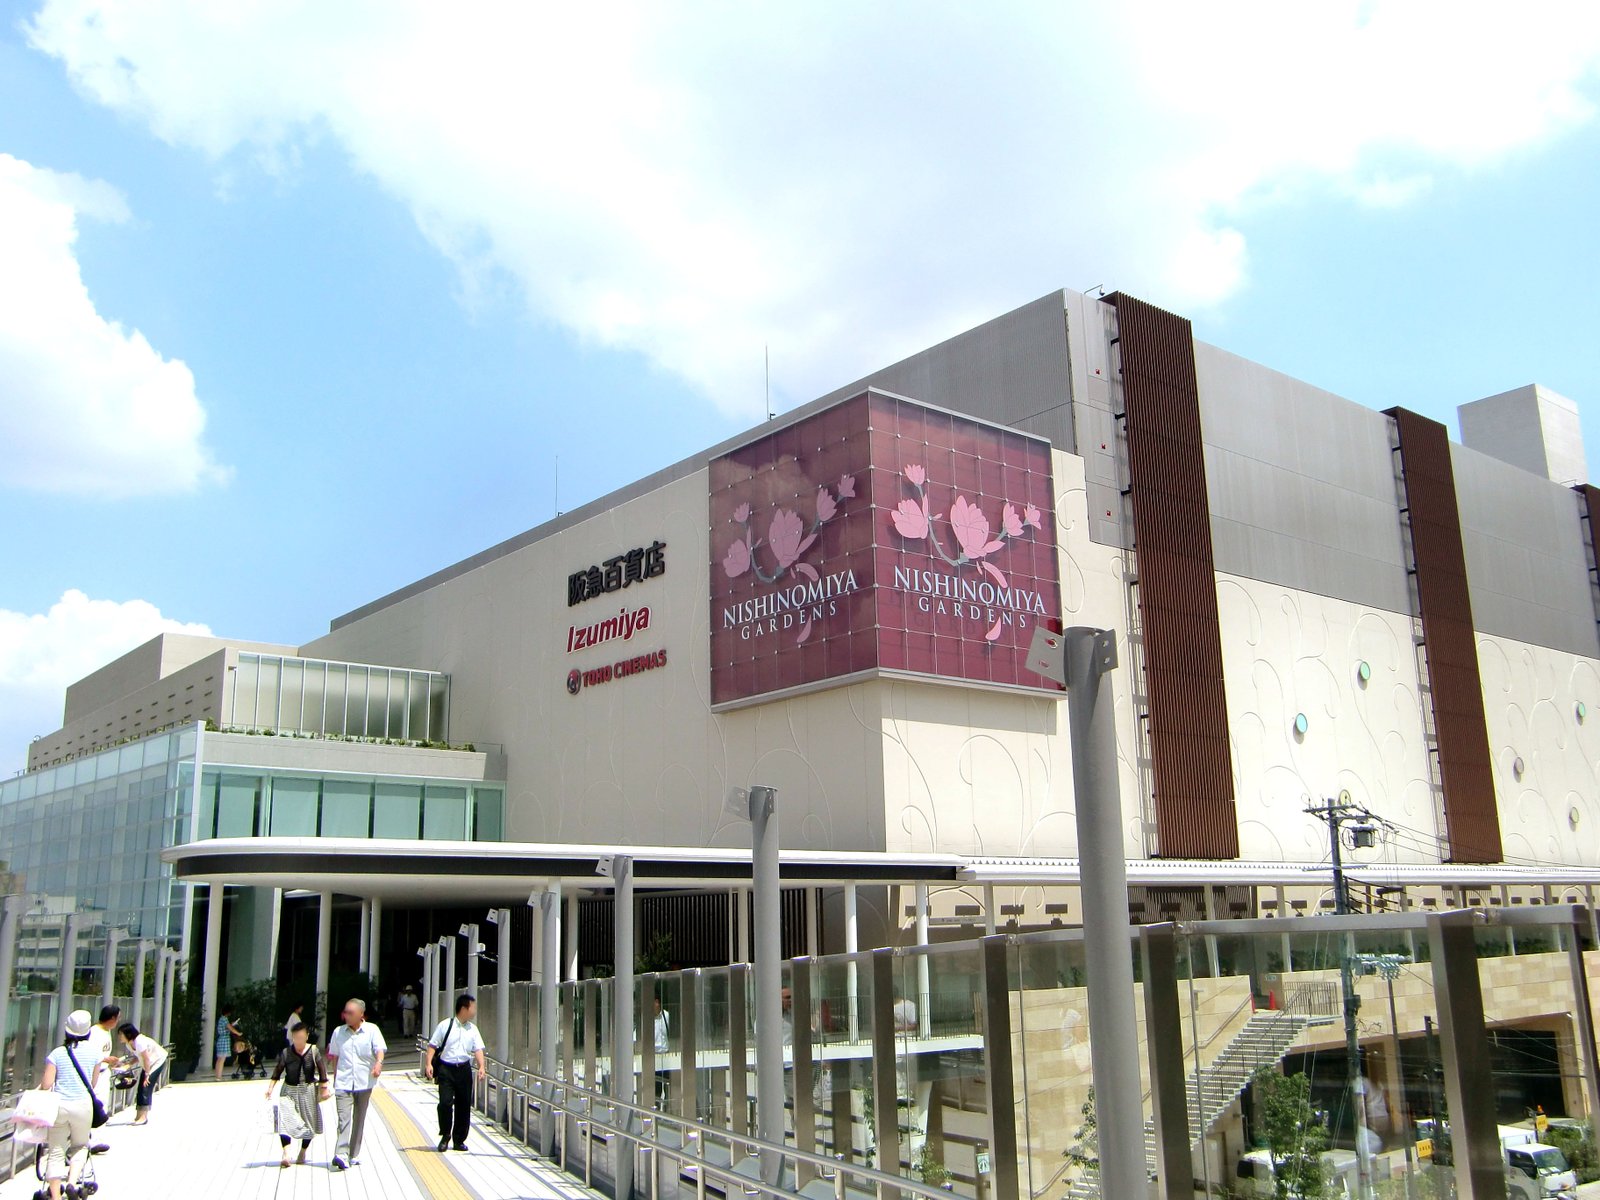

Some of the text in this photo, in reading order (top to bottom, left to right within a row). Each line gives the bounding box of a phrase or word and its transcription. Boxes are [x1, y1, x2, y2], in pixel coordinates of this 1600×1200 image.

[568, 541, 666, 607] 阪急百貨店
[894, 565, 1047, 614] NISHINOMIYA
[723, 568, 859, 628] NISHINOMIYA
[741, 600, 836, 640] GARDENS
[919, 597, 1026, 628] GARDENS
[567, 606, 651, 653] Izumiya
[582, 649, 667, 687] TOHO CINEMAS
